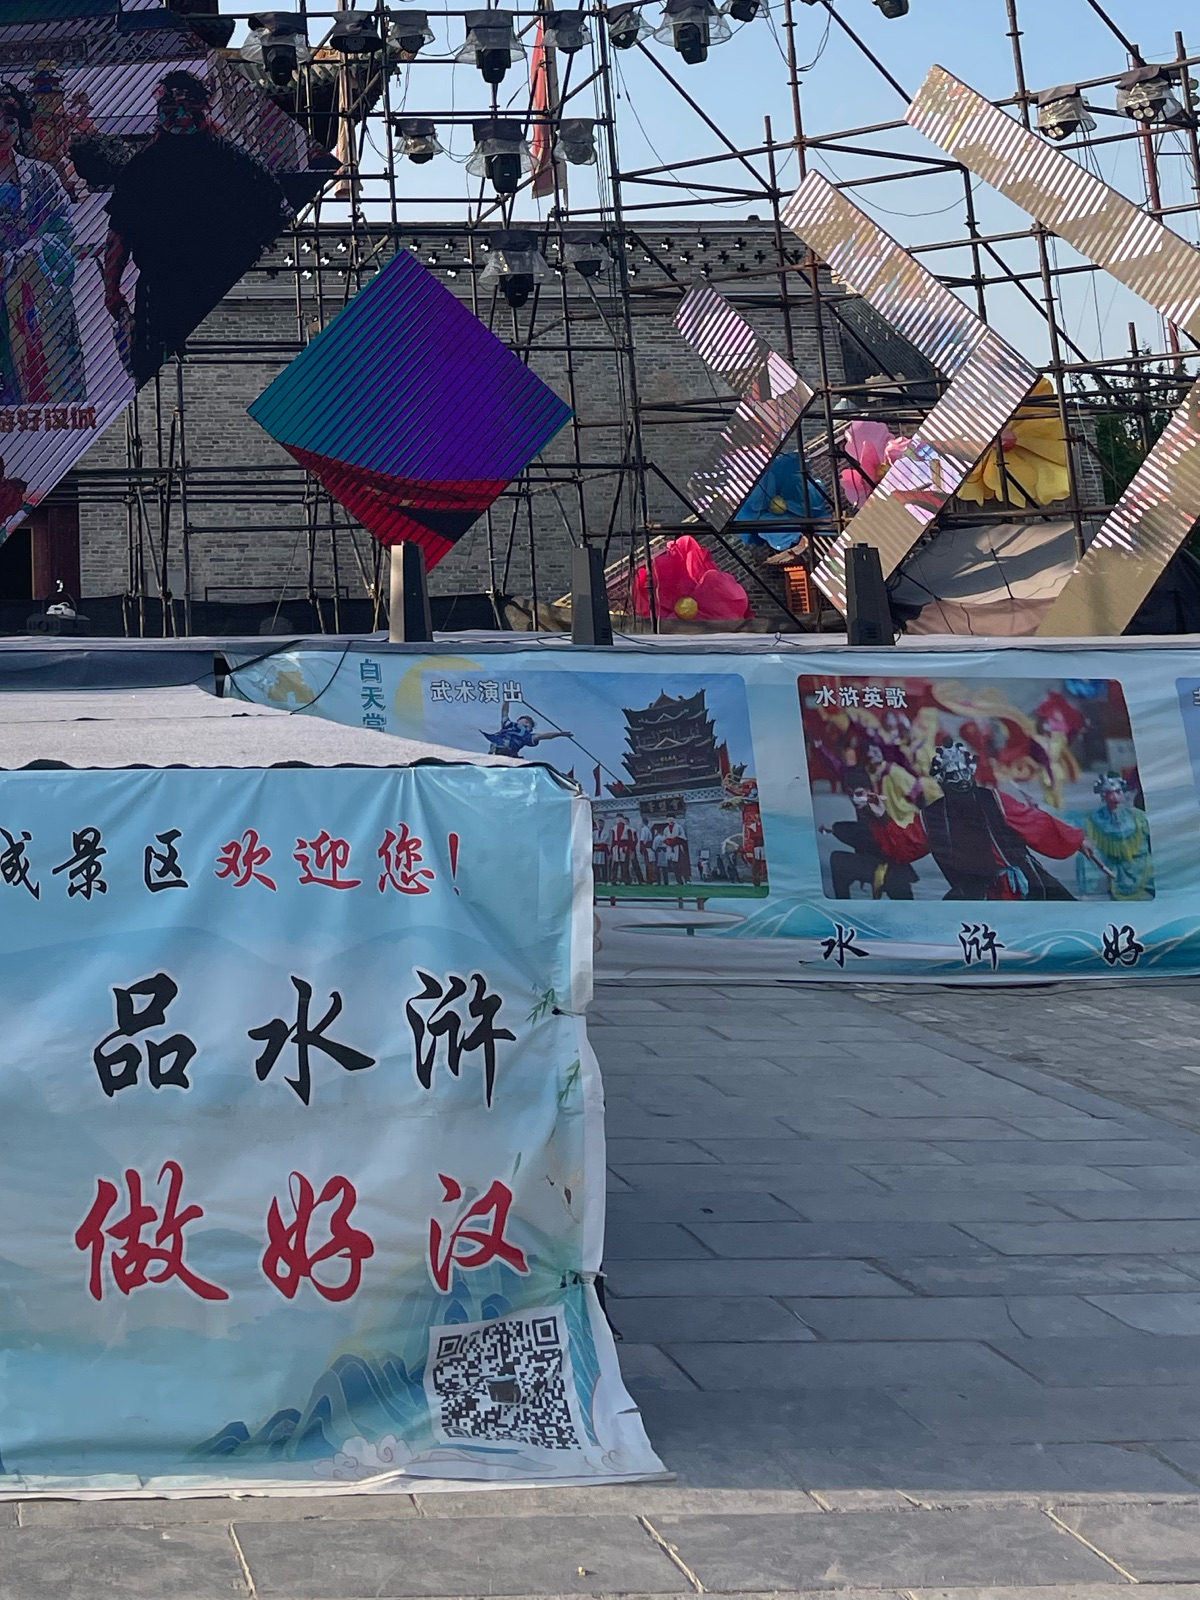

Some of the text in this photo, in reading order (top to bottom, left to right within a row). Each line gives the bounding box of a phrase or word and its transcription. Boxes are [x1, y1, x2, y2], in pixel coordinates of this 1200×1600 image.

[430, 681, 523, 703] 武术演出
[815, 686, 908, 708] 水浒英歌
[93, 968, 517, 1108] 品水浒
[75, 1160, 528, 1301] 做好汉
